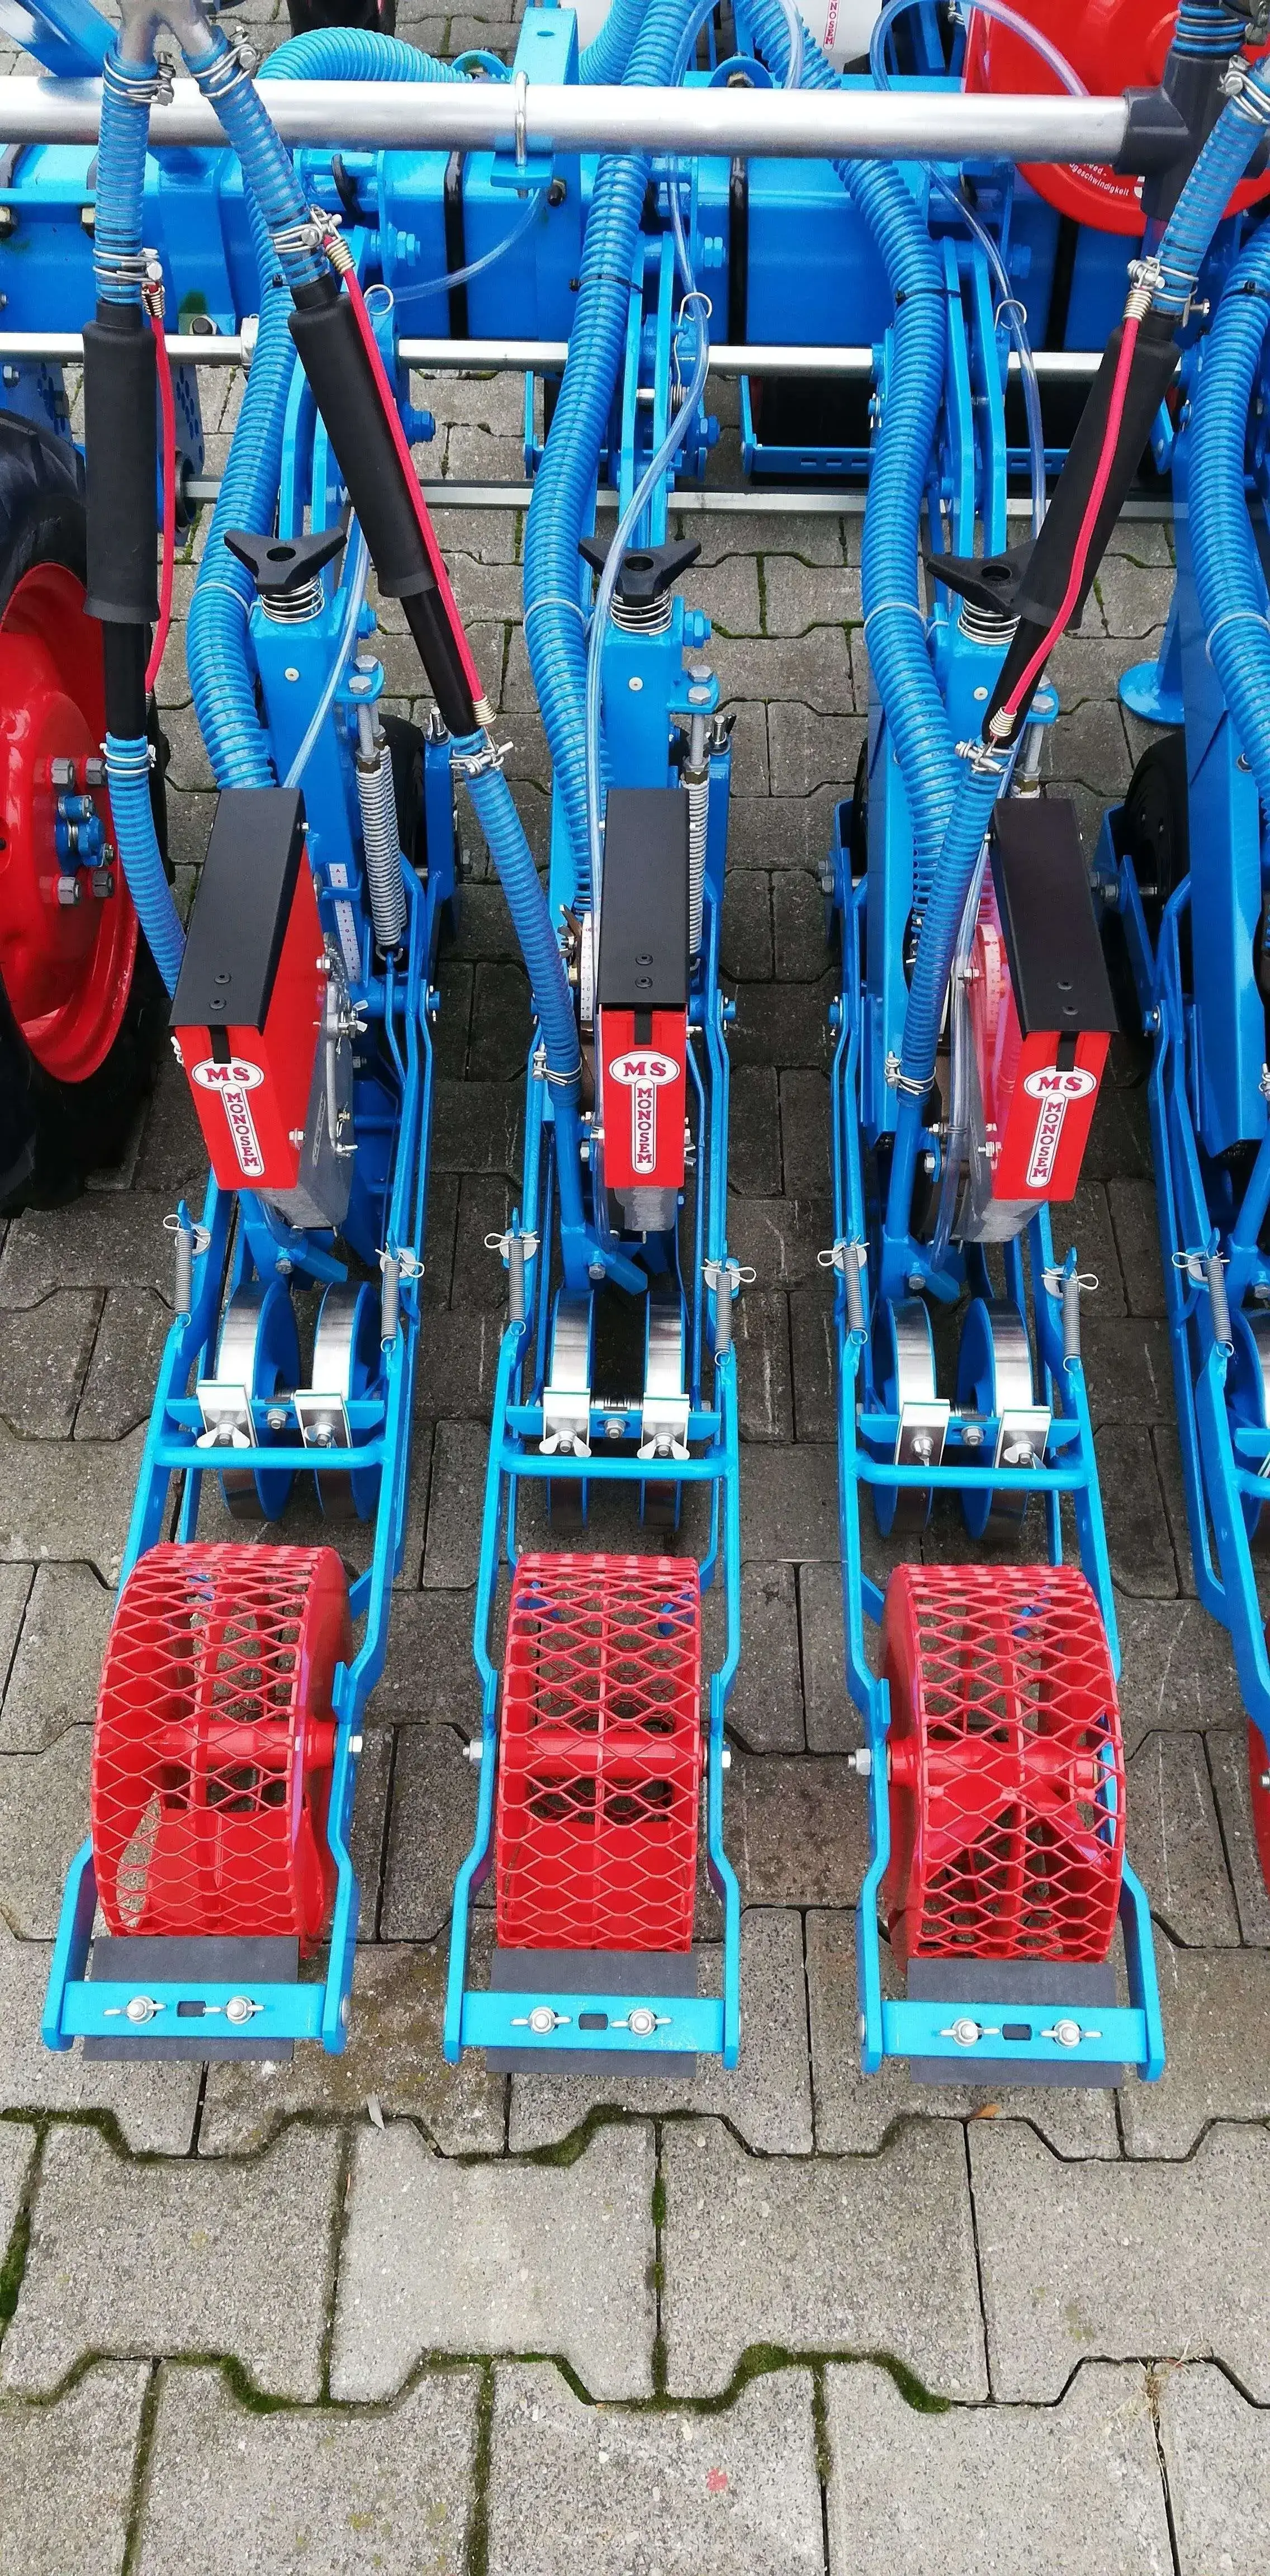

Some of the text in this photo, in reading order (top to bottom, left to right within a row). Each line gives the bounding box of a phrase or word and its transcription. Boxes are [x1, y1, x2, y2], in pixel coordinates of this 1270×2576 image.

[825, 0, 837, 44] NOSEM
[205, 1067, 250, 1082] MS
[623, 1062, 666, 1077] MS
[1037, 1076, 1082, 1091] MS
[225, 1093, 259, 1166] MONOSEM
[637, 1088, 653, 1163] MONOSEM
[1032, 1102, 1063, 1177] MONOSEM
